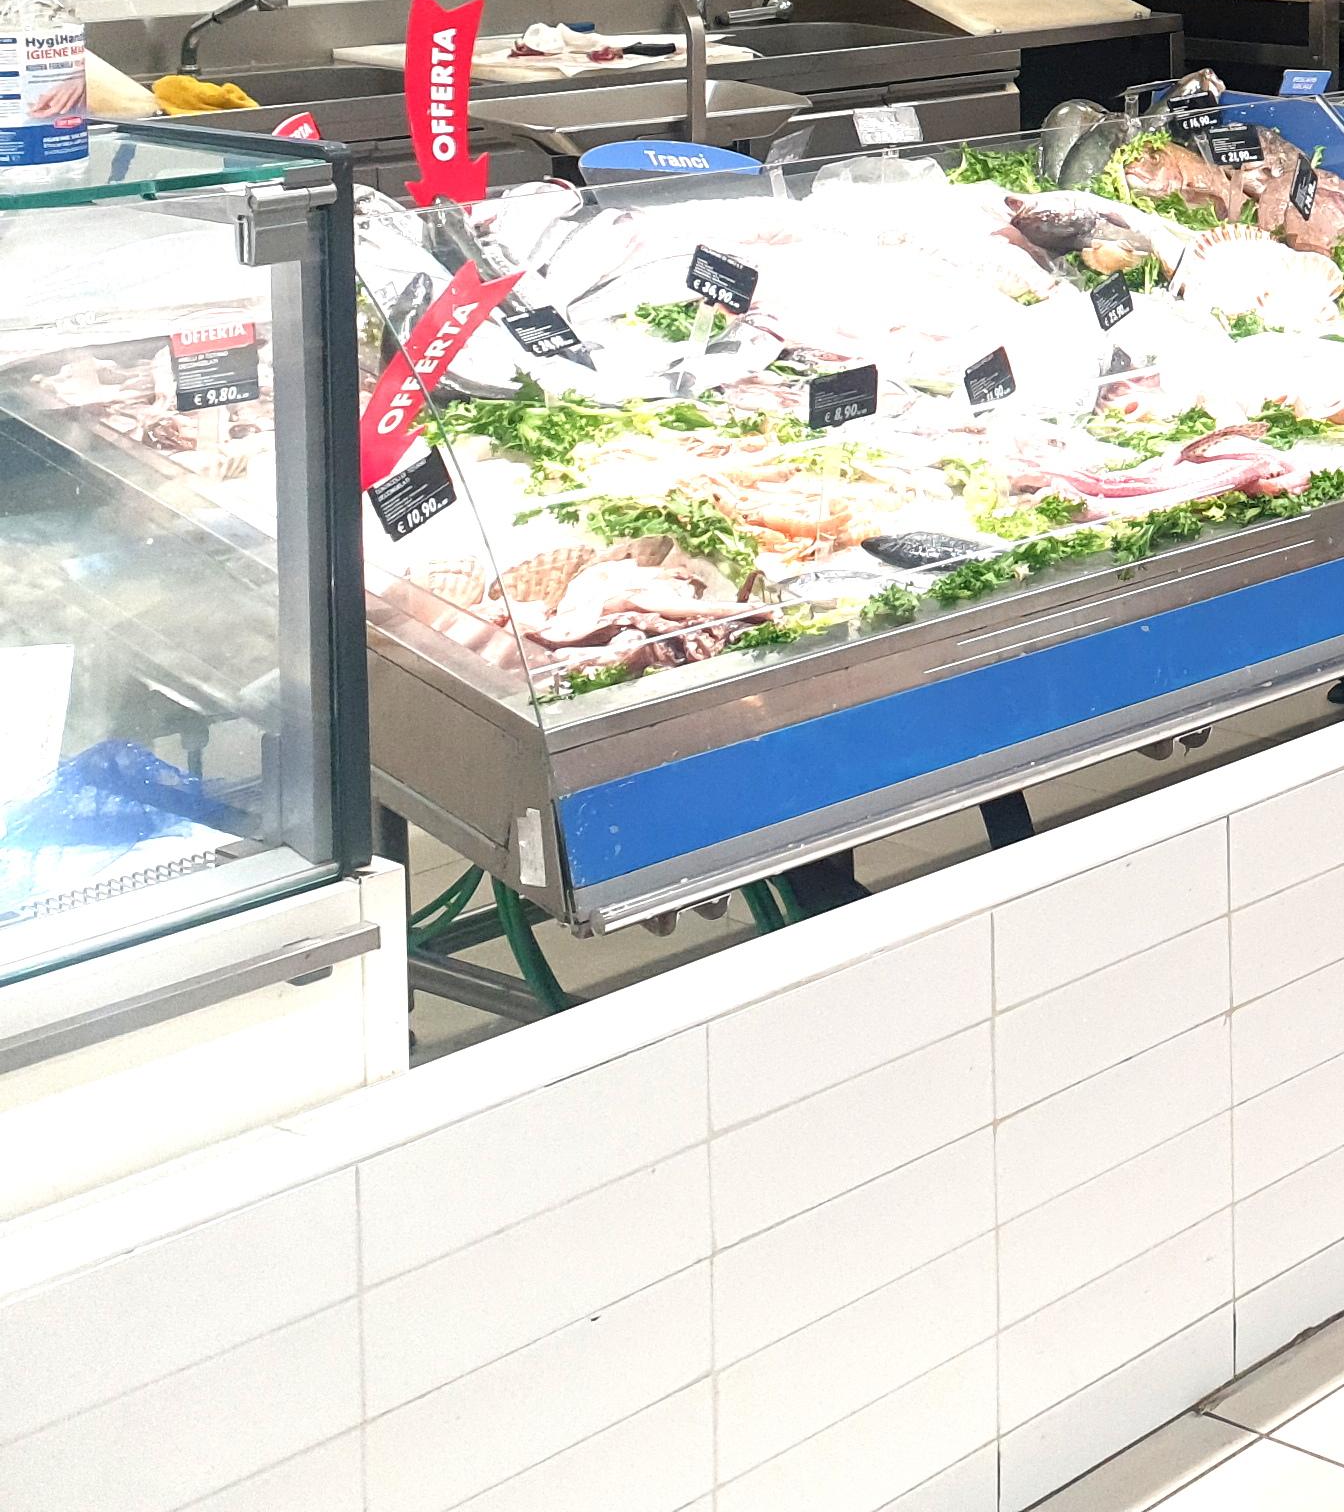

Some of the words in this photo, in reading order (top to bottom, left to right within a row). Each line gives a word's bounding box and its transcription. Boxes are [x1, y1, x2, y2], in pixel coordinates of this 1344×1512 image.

[26, 48, 69, 60] IGIENE
[430, 27, 458, 163] OFFERTA
[644, 149, 710, 170] Tranci
[180, 323, 247, 345] OFFERTA
[376, 301, 480, 435] OFFERTA
[206, 385, 238, 405] 9,80
[406, 497, 437, 528] 10,90
